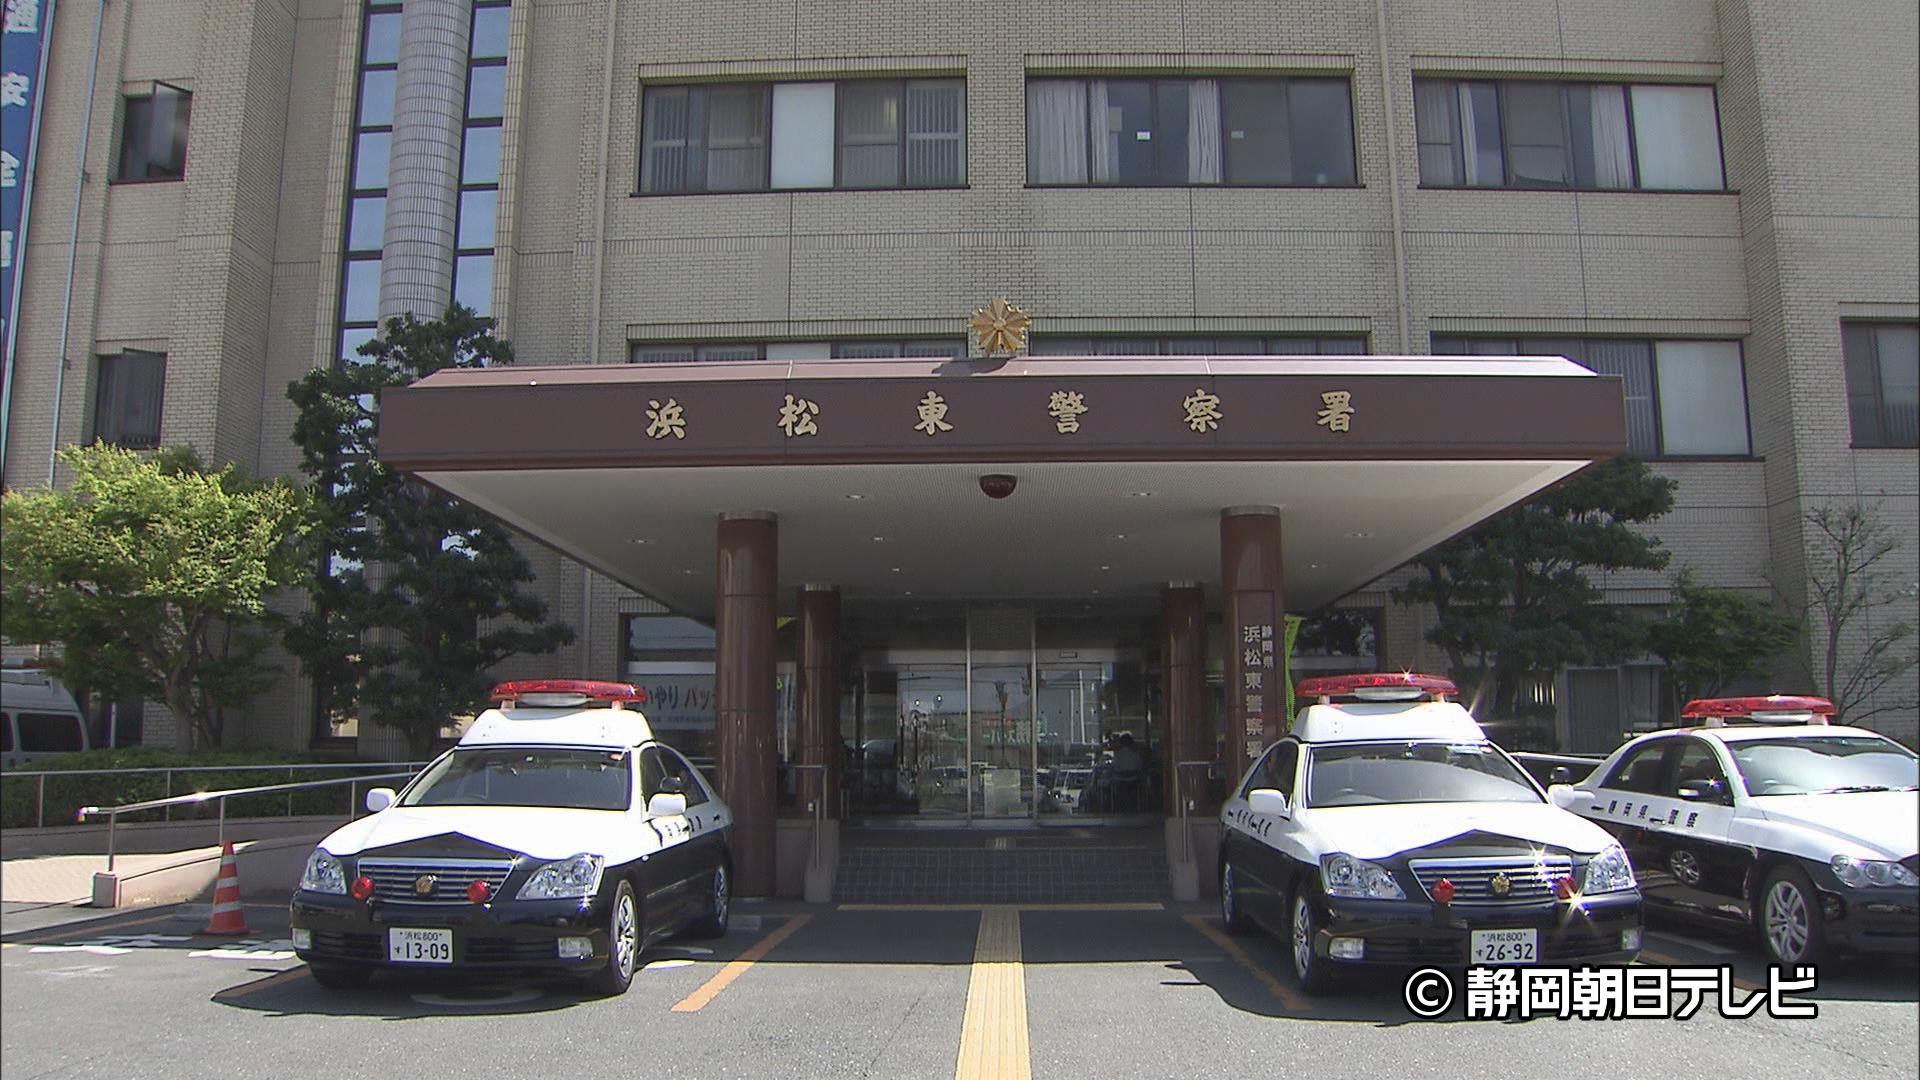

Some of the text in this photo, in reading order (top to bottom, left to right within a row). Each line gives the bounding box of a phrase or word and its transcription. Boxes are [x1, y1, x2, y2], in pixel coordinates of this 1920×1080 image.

[645, 388, 1355, 440] 浜松東警察署
[1261, 625, 1274, 669] 静岡県
[1244, 625, 1263, 760] 浜松東警察署
[406, 942, 449, 959] 13-09
[1485, 943, 1533, 960] 26-92
